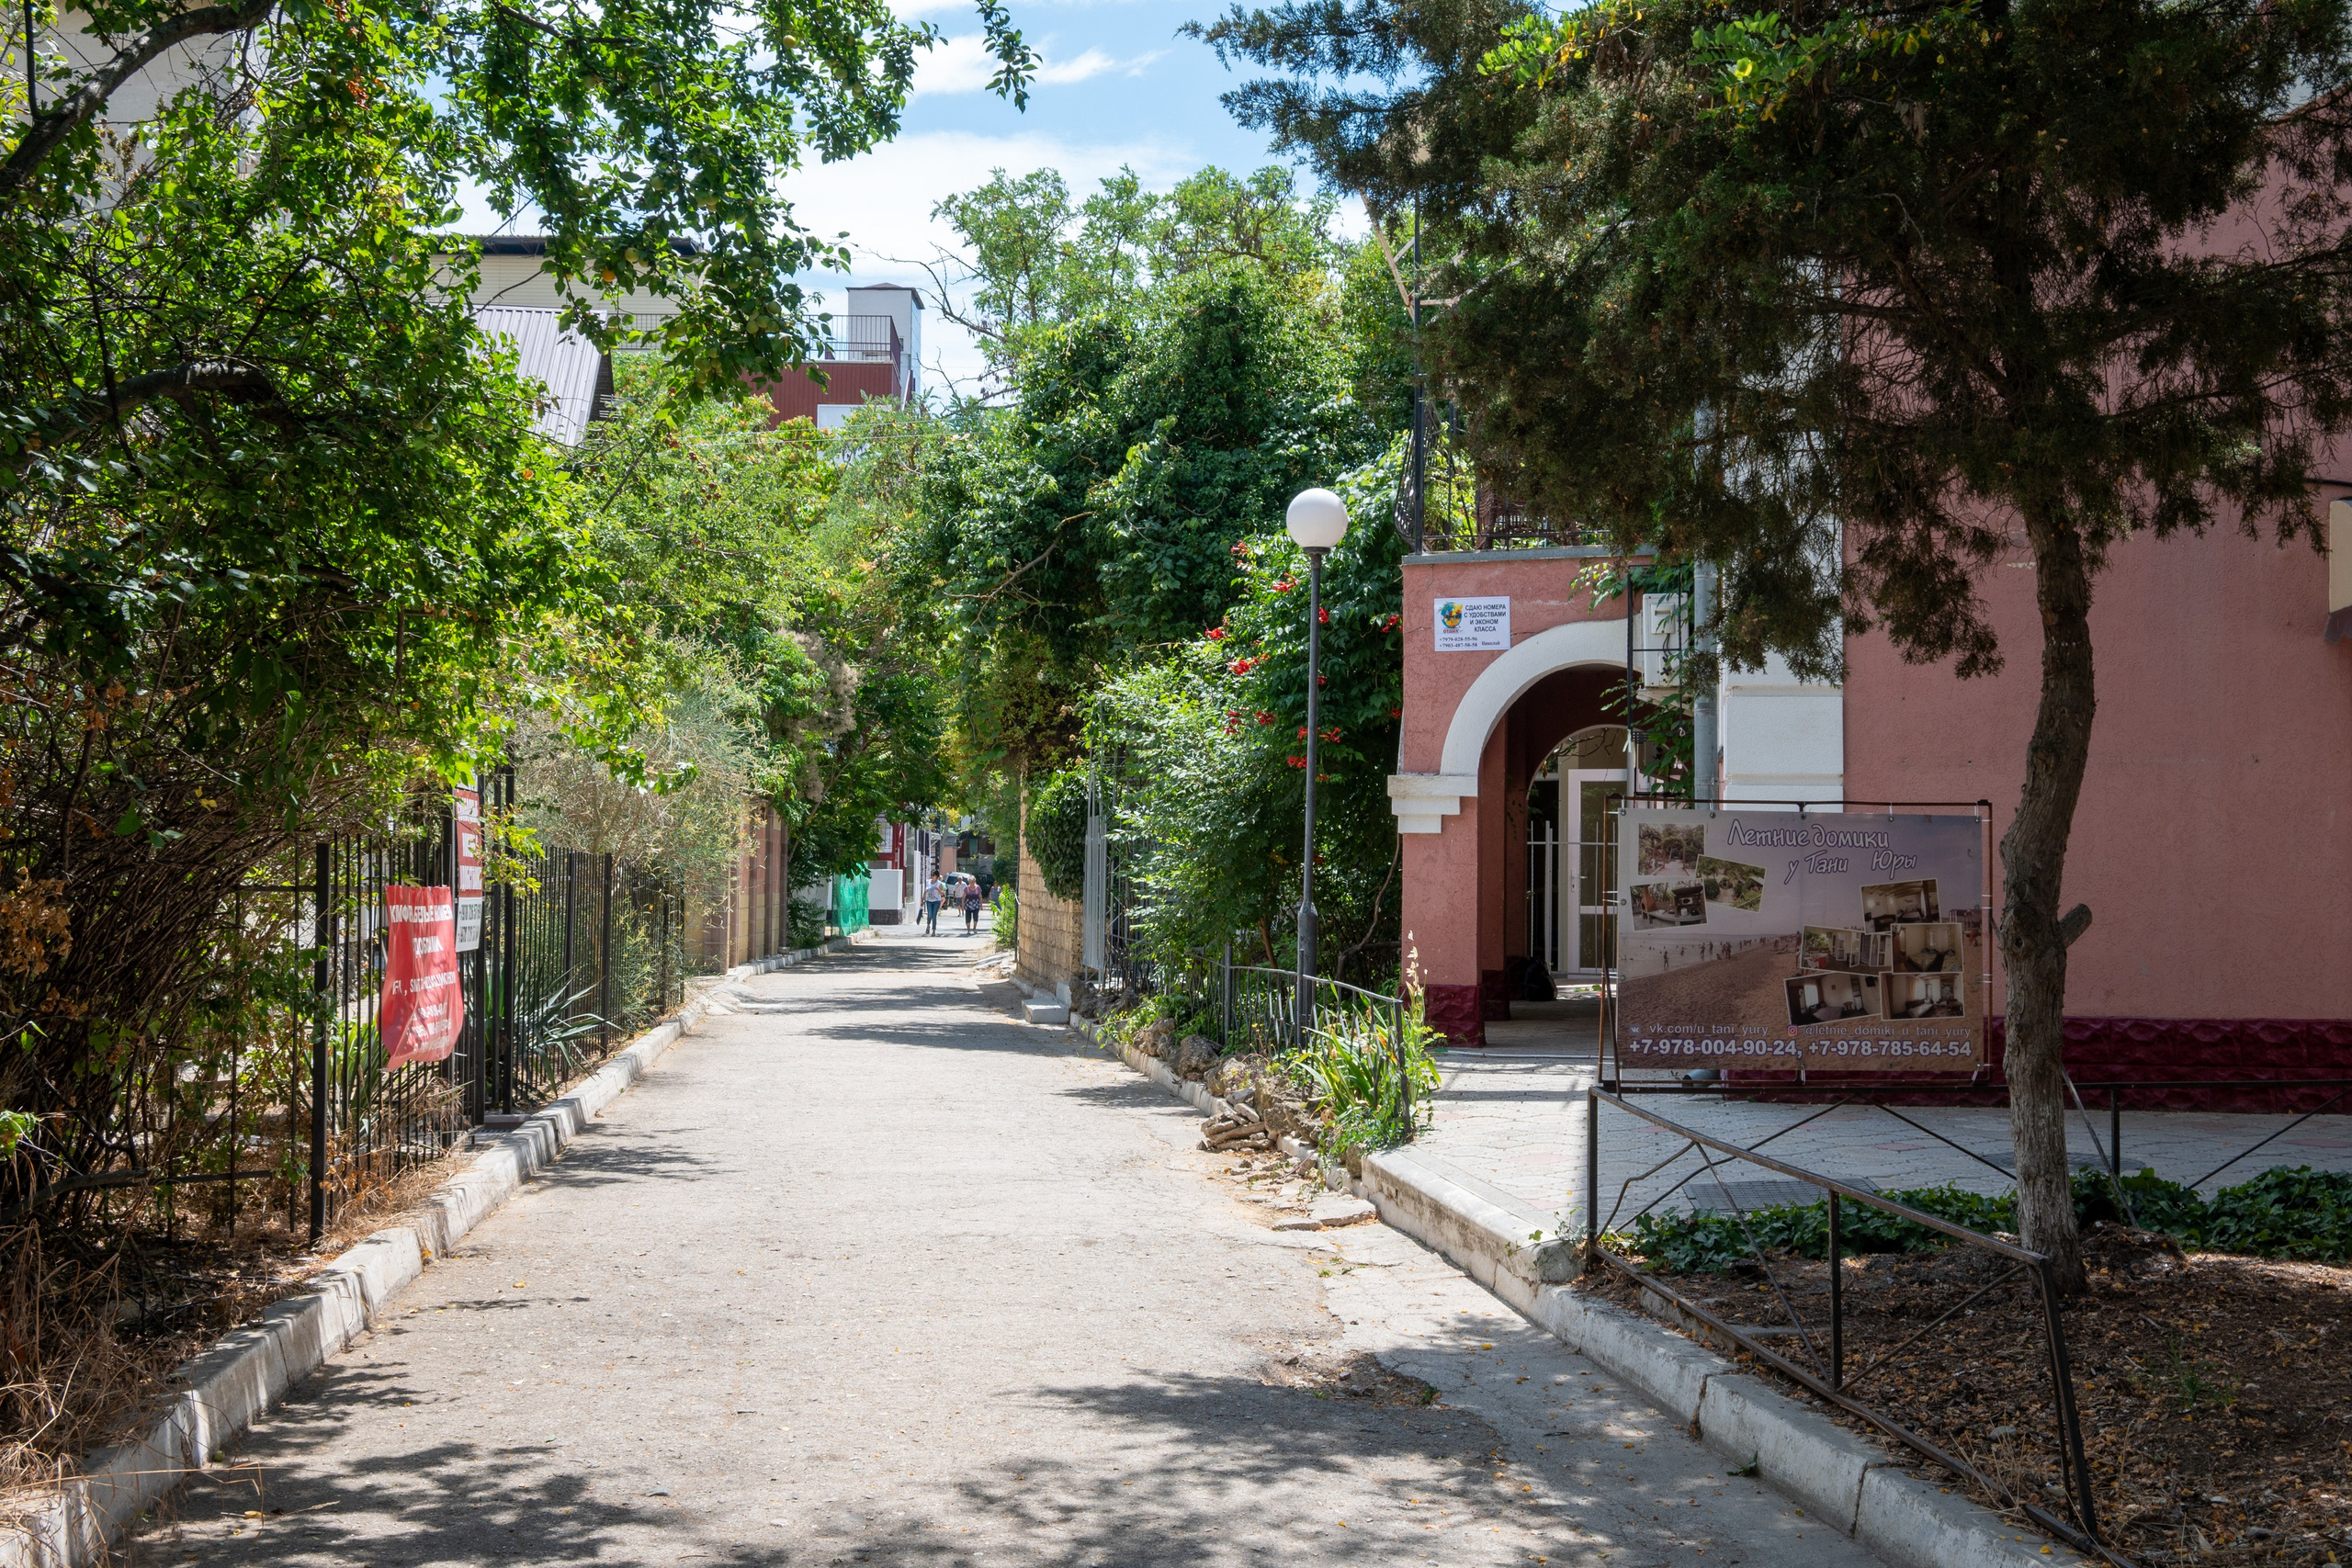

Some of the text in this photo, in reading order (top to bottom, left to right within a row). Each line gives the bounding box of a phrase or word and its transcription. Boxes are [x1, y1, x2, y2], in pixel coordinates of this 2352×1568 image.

[1727, 818, 1889, 849] Летние домики
[1784, 850, 1917, 885] у Тани Юры
[1649, 1023, 1769, 1037] vk.com/u_tani_yury
[1803, 1024, 1972, 1039] @letnie_domiki_u_tani_yury
[1629, 1038, 1972, 1058] +7-978-004-90-24, +7-978-785-64-54
